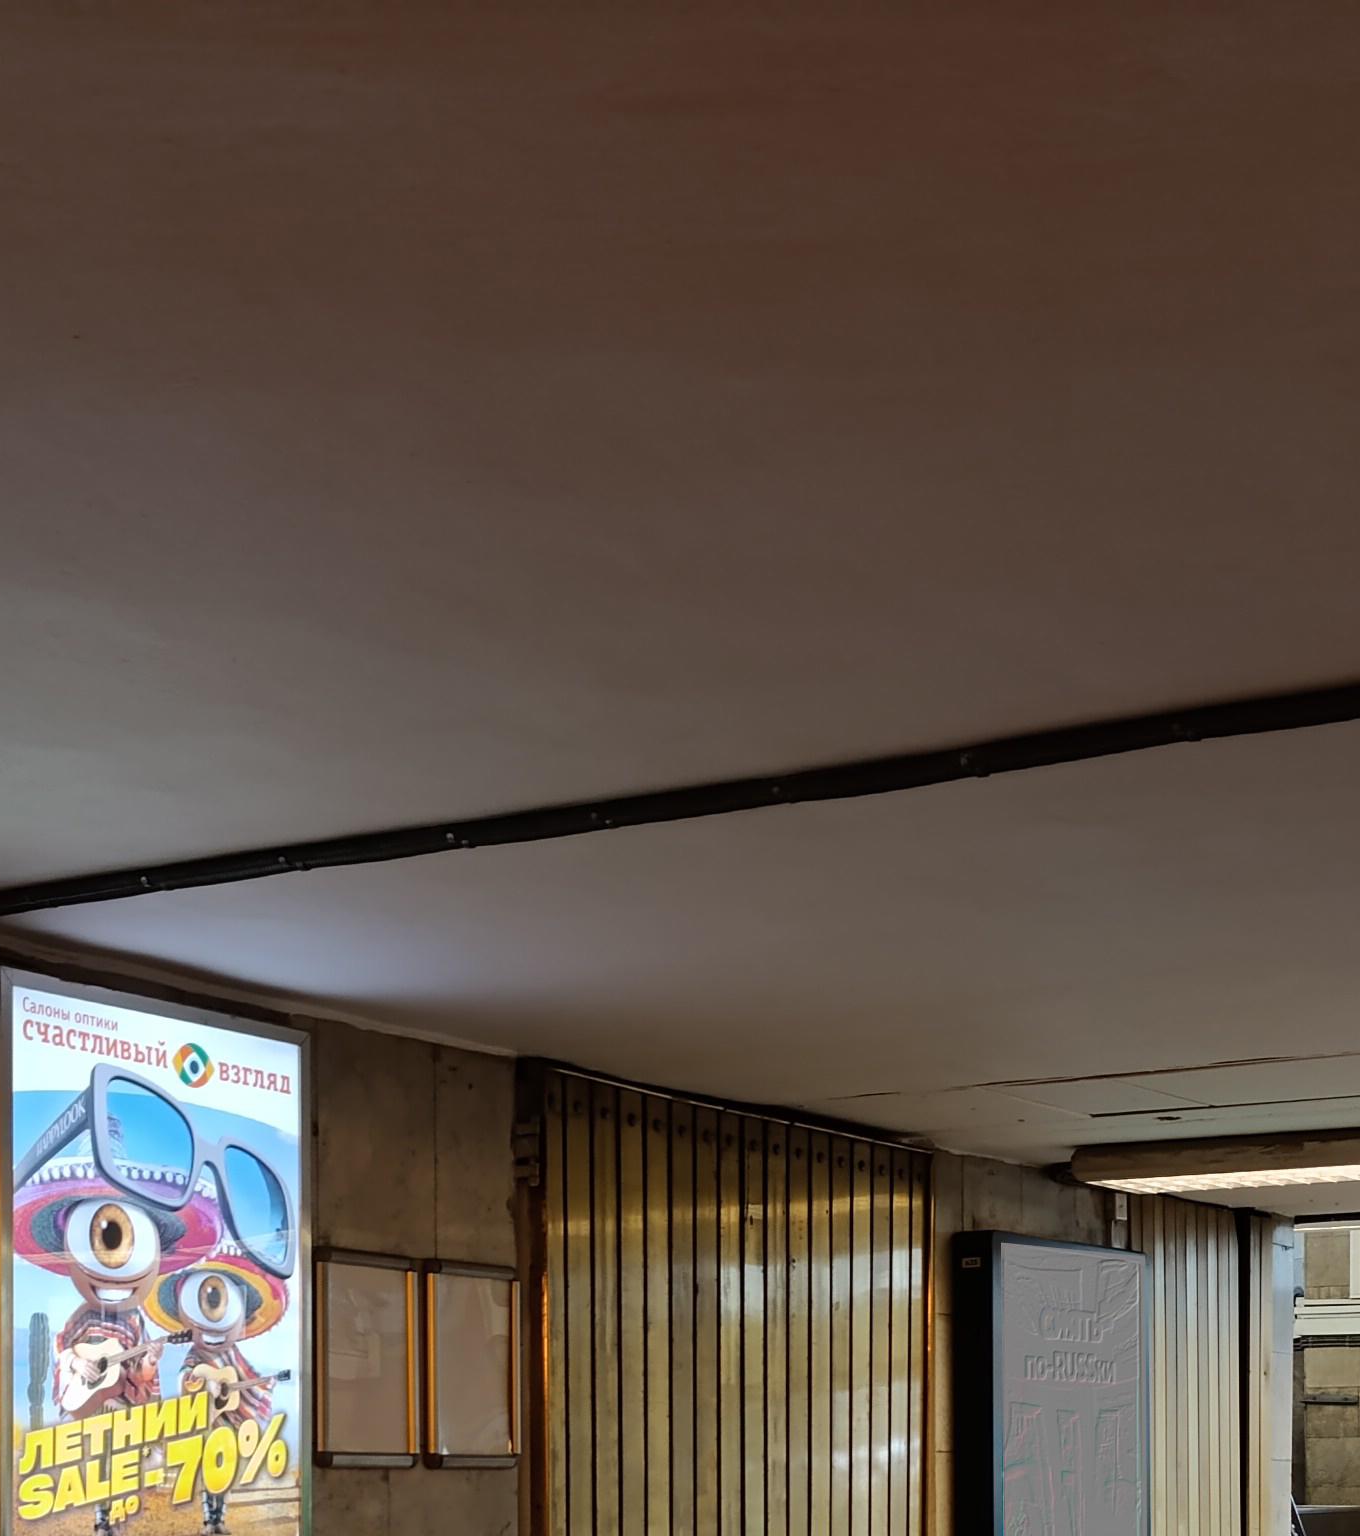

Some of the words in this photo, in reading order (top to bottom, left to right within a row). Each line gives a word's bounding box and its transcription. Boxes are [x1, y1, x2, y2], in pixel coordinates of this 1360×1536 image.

[22, 996, 70, 1022] Салоны
[74, 1010, 119, 1031] оптики
[19, 1375, 209, 1476] ЛЕТНИЙ
[109, 1495, 139, 1525] до
